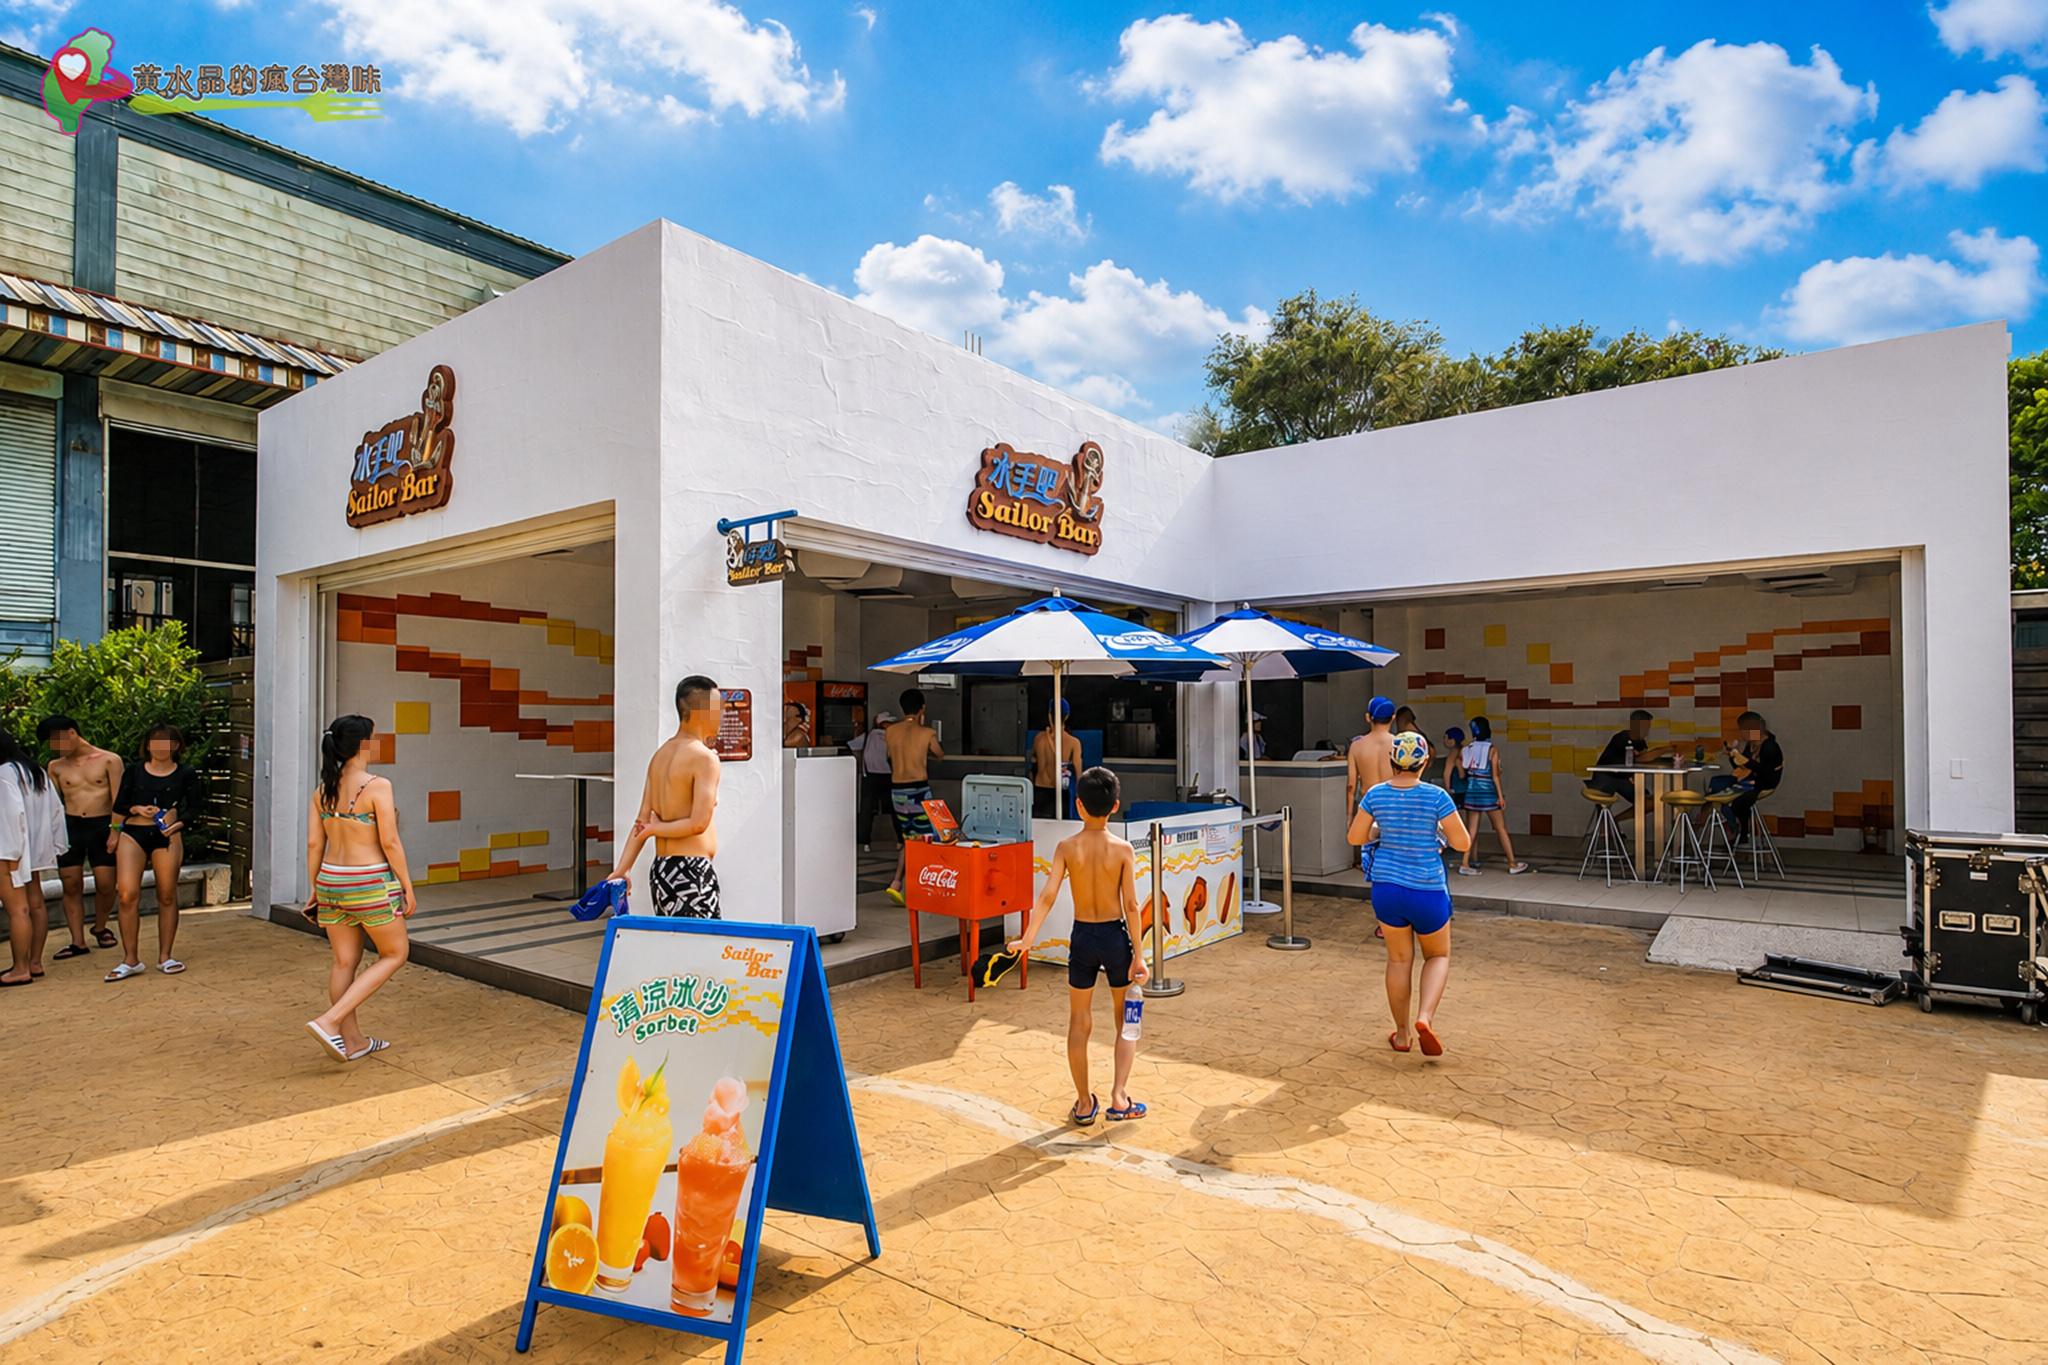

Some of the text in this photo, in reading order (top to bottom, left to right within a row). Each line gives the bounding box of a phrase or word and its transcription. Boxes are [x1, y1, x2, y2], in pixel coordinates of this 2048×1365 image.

[354, 429, 404, 484] 水手吧
[987, 451, 1060, 507] 水手吧
[347, 469, 438, 517] Sailor Bar
[976, 490, 1100, 547] Sailor Bar
[763, 562, 785, 575] Bar
[721, 944, 774, 963] Sailor
[745, 960, 783, 980] Bar
[610, 976, 728, 1034] 清涼冰沙
[635, 1013, 697, 1042] sorbet
